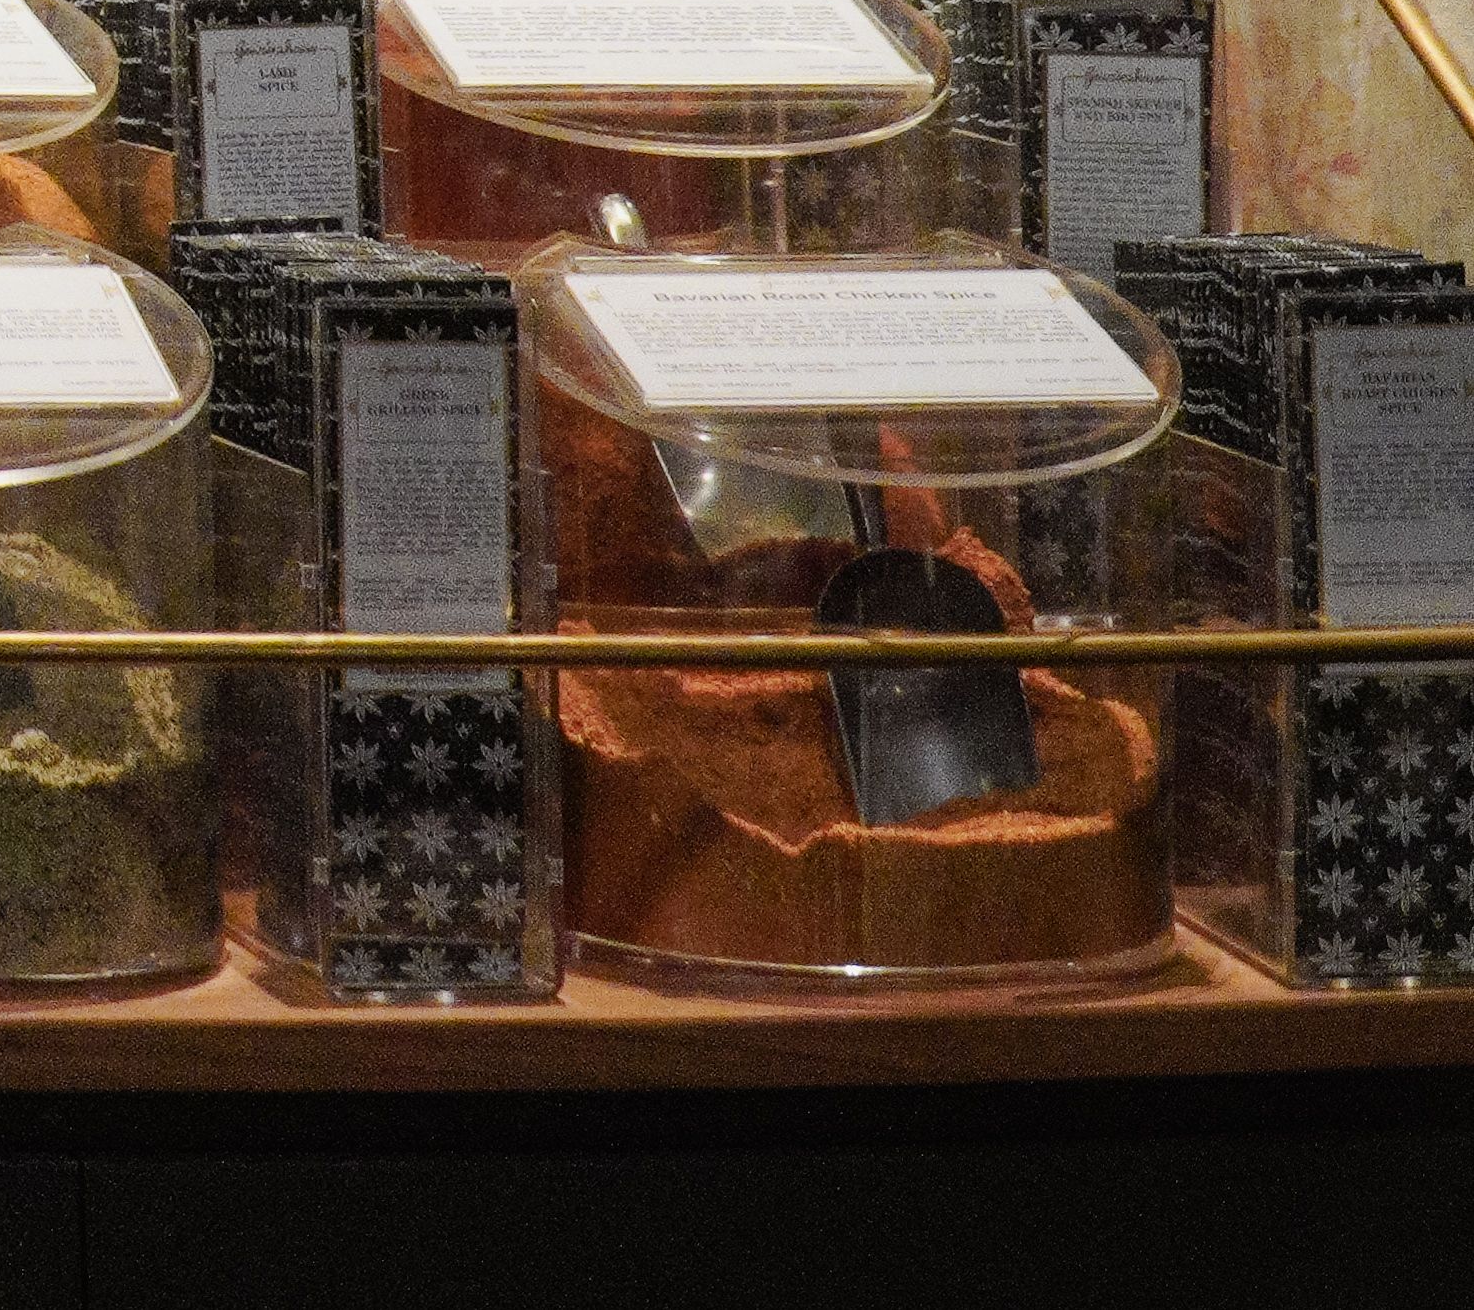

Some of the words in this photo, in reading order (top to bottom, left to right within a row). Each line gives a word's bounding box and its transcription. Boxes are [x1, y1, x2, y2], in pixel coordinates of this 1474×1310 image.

[652, 290, 755, 303] Bavarian
[760, 289, 828, 302] Roast
[834, 289, 928, 301] Chicken
[932, 289, 999, 303] Spice
